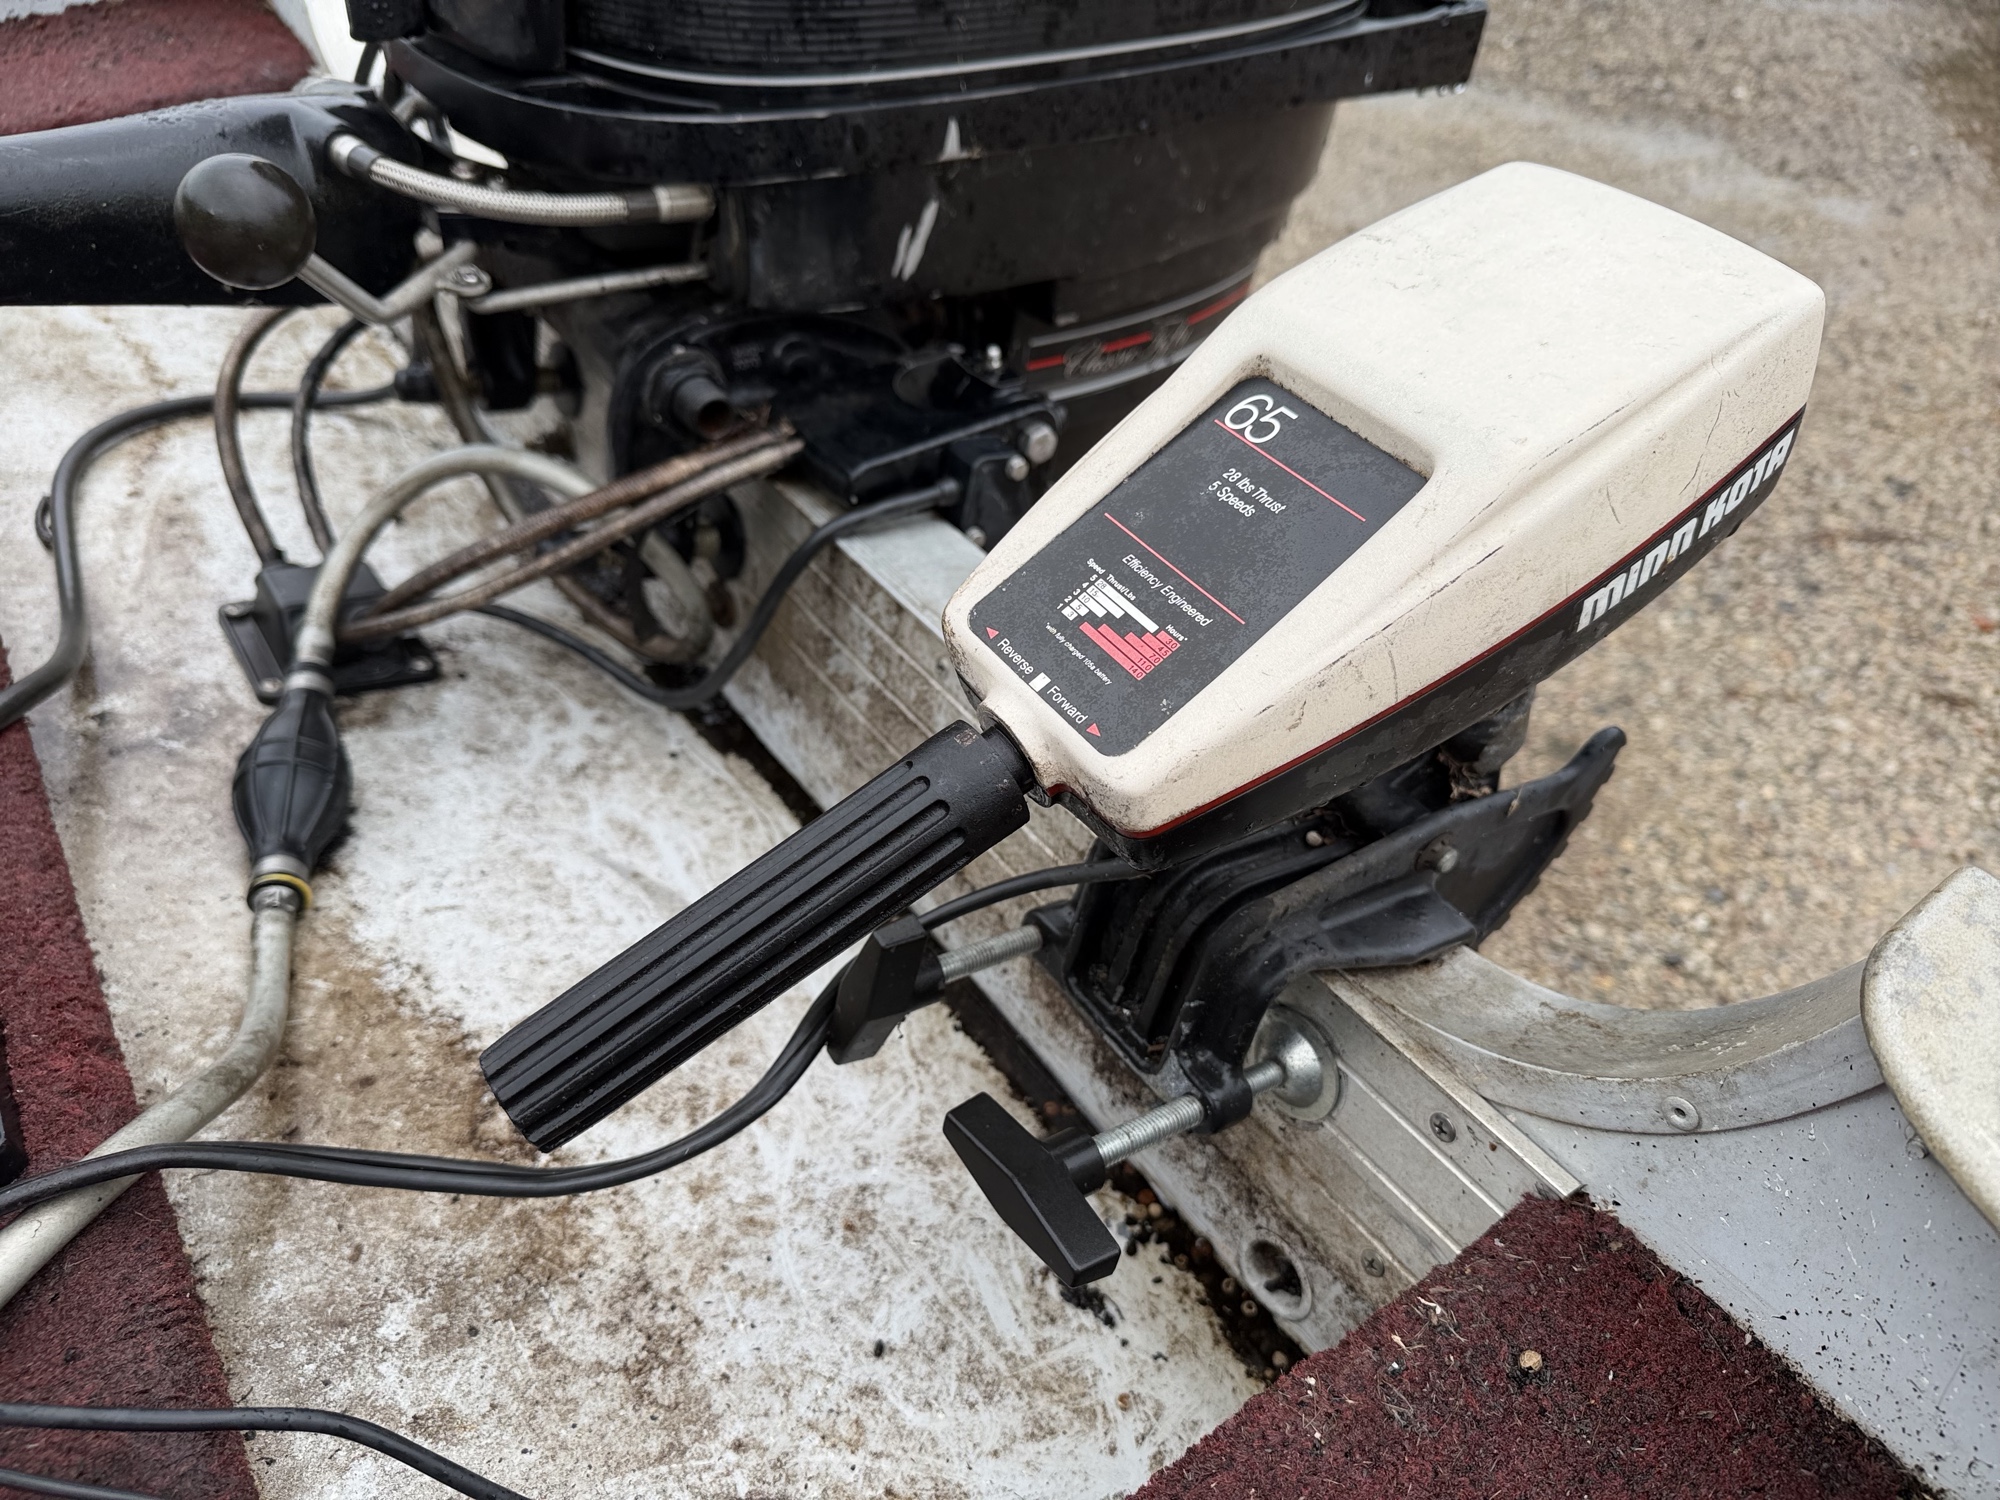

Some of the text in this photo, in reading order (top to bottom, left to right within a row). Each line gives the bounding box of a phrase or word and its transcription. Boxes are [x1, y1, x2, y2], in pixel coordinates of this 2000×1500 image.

[1224, 393, 1298, 444] 65
[1208, 480, 1256, 518] 5 Speeds
[1222, 467, 1287, 515] 28 lbs Thrust
[1698, 428, 1795, 540] KOTA
[1086, 558, 1106, 575] Speed
[1089, 574, 1098, 582] 5
[1096, 580, 1107, 590] 28
[1064, 595, 1073, 603] 2
[1072, 588, 1081, 596] 3
[1081, 594, 1091, 604] 10
[1089, 588, 1099, 598] 15
[1122, 553, 1213, 628] Efficiency Engineered
[996, 637, 1035, 675] Reverse
[1046, 685, 1089, 725] Forward
